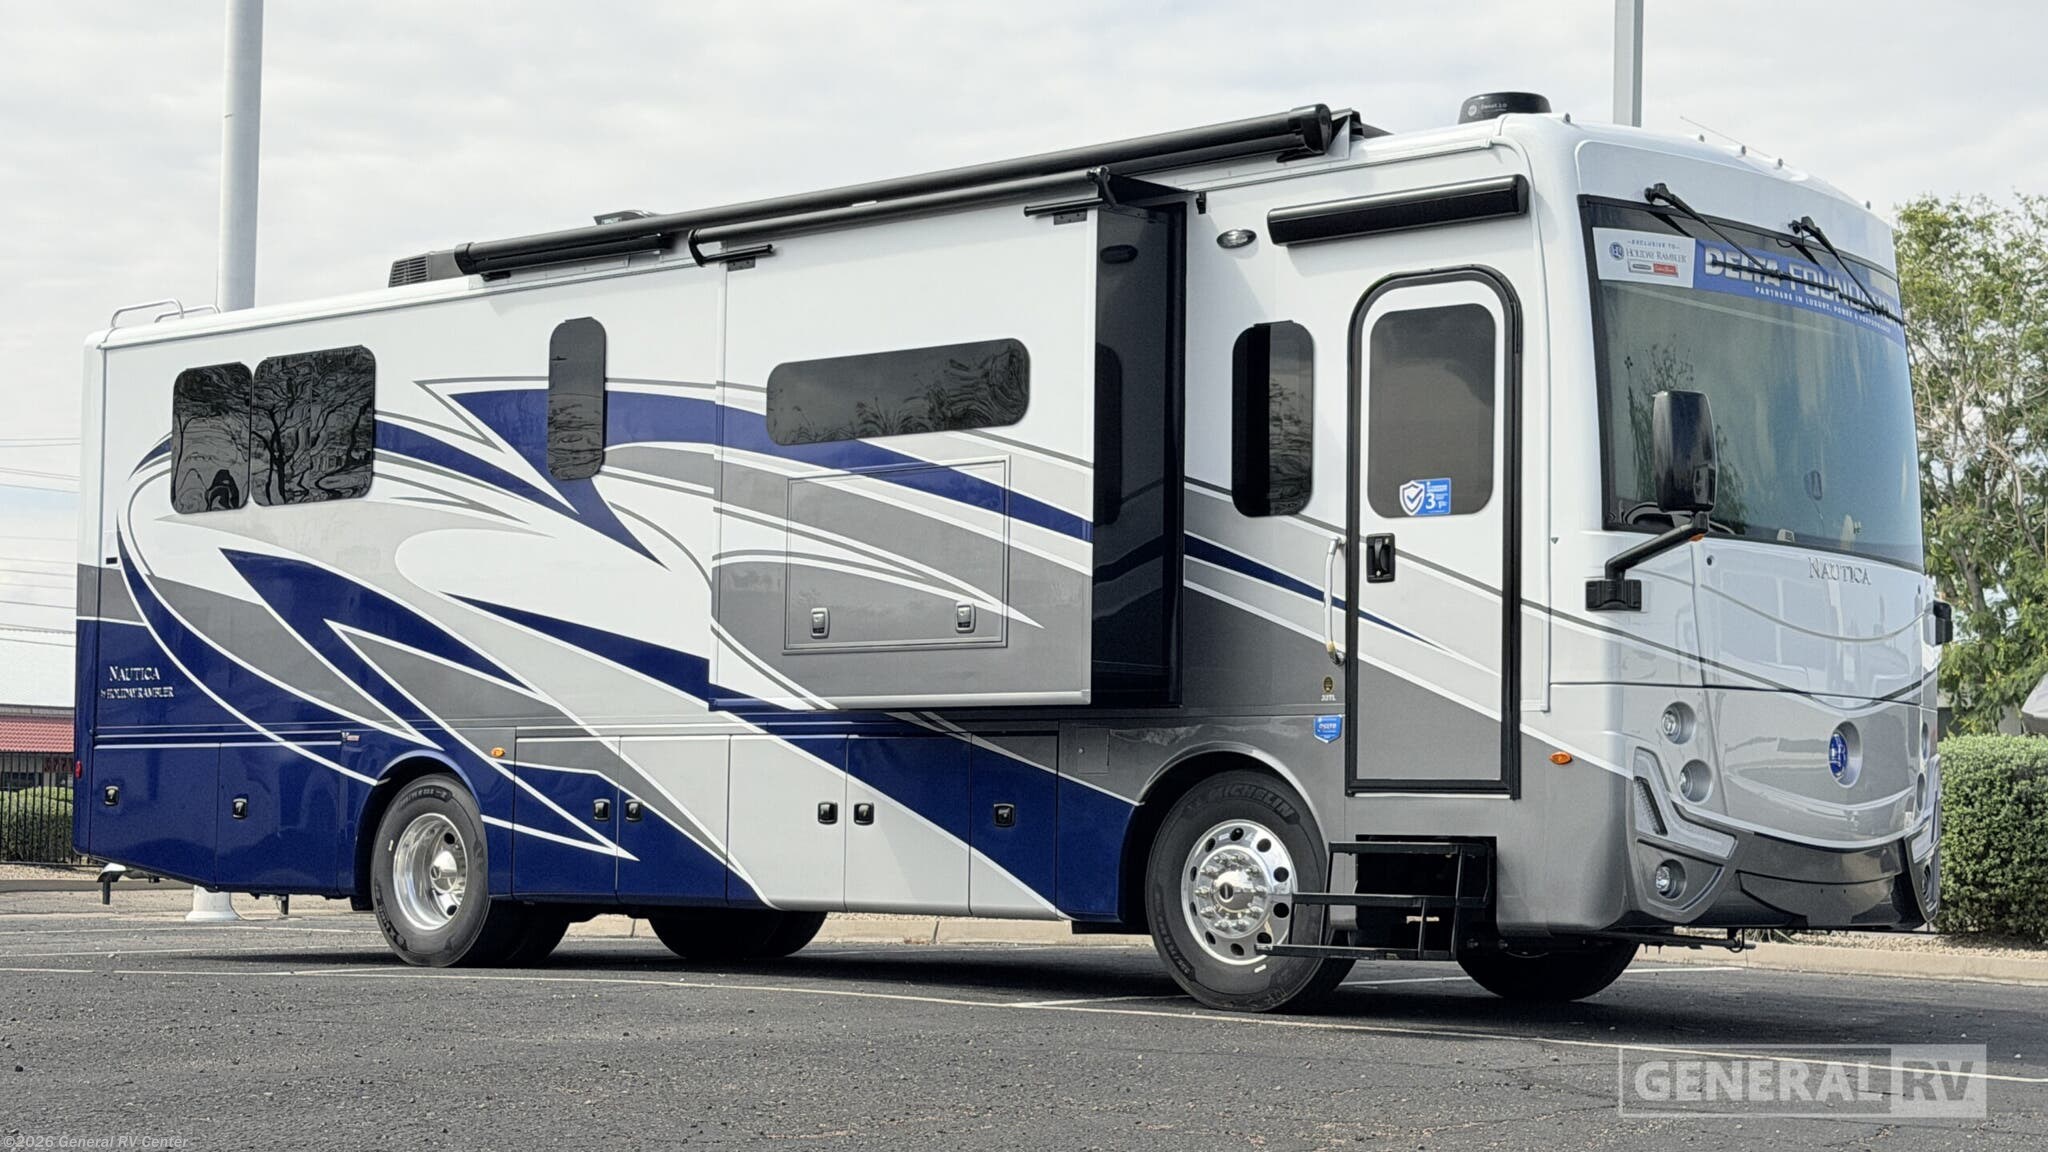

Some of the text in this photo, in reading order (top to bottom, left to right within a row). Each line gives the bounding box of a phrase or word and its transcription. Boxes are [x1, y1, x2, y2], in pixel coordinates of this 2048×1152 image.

[1705, 247, 1780, 288] DELTA
[1755, 286, 1793, 301] PARTNERS
[1795, 295, 1804, 304] IN
[1425, 492, 1436, 509] 3
[1808, 557, 1872, 586] NAUTICA
[109, 666, 161, 681] NAUTICA
